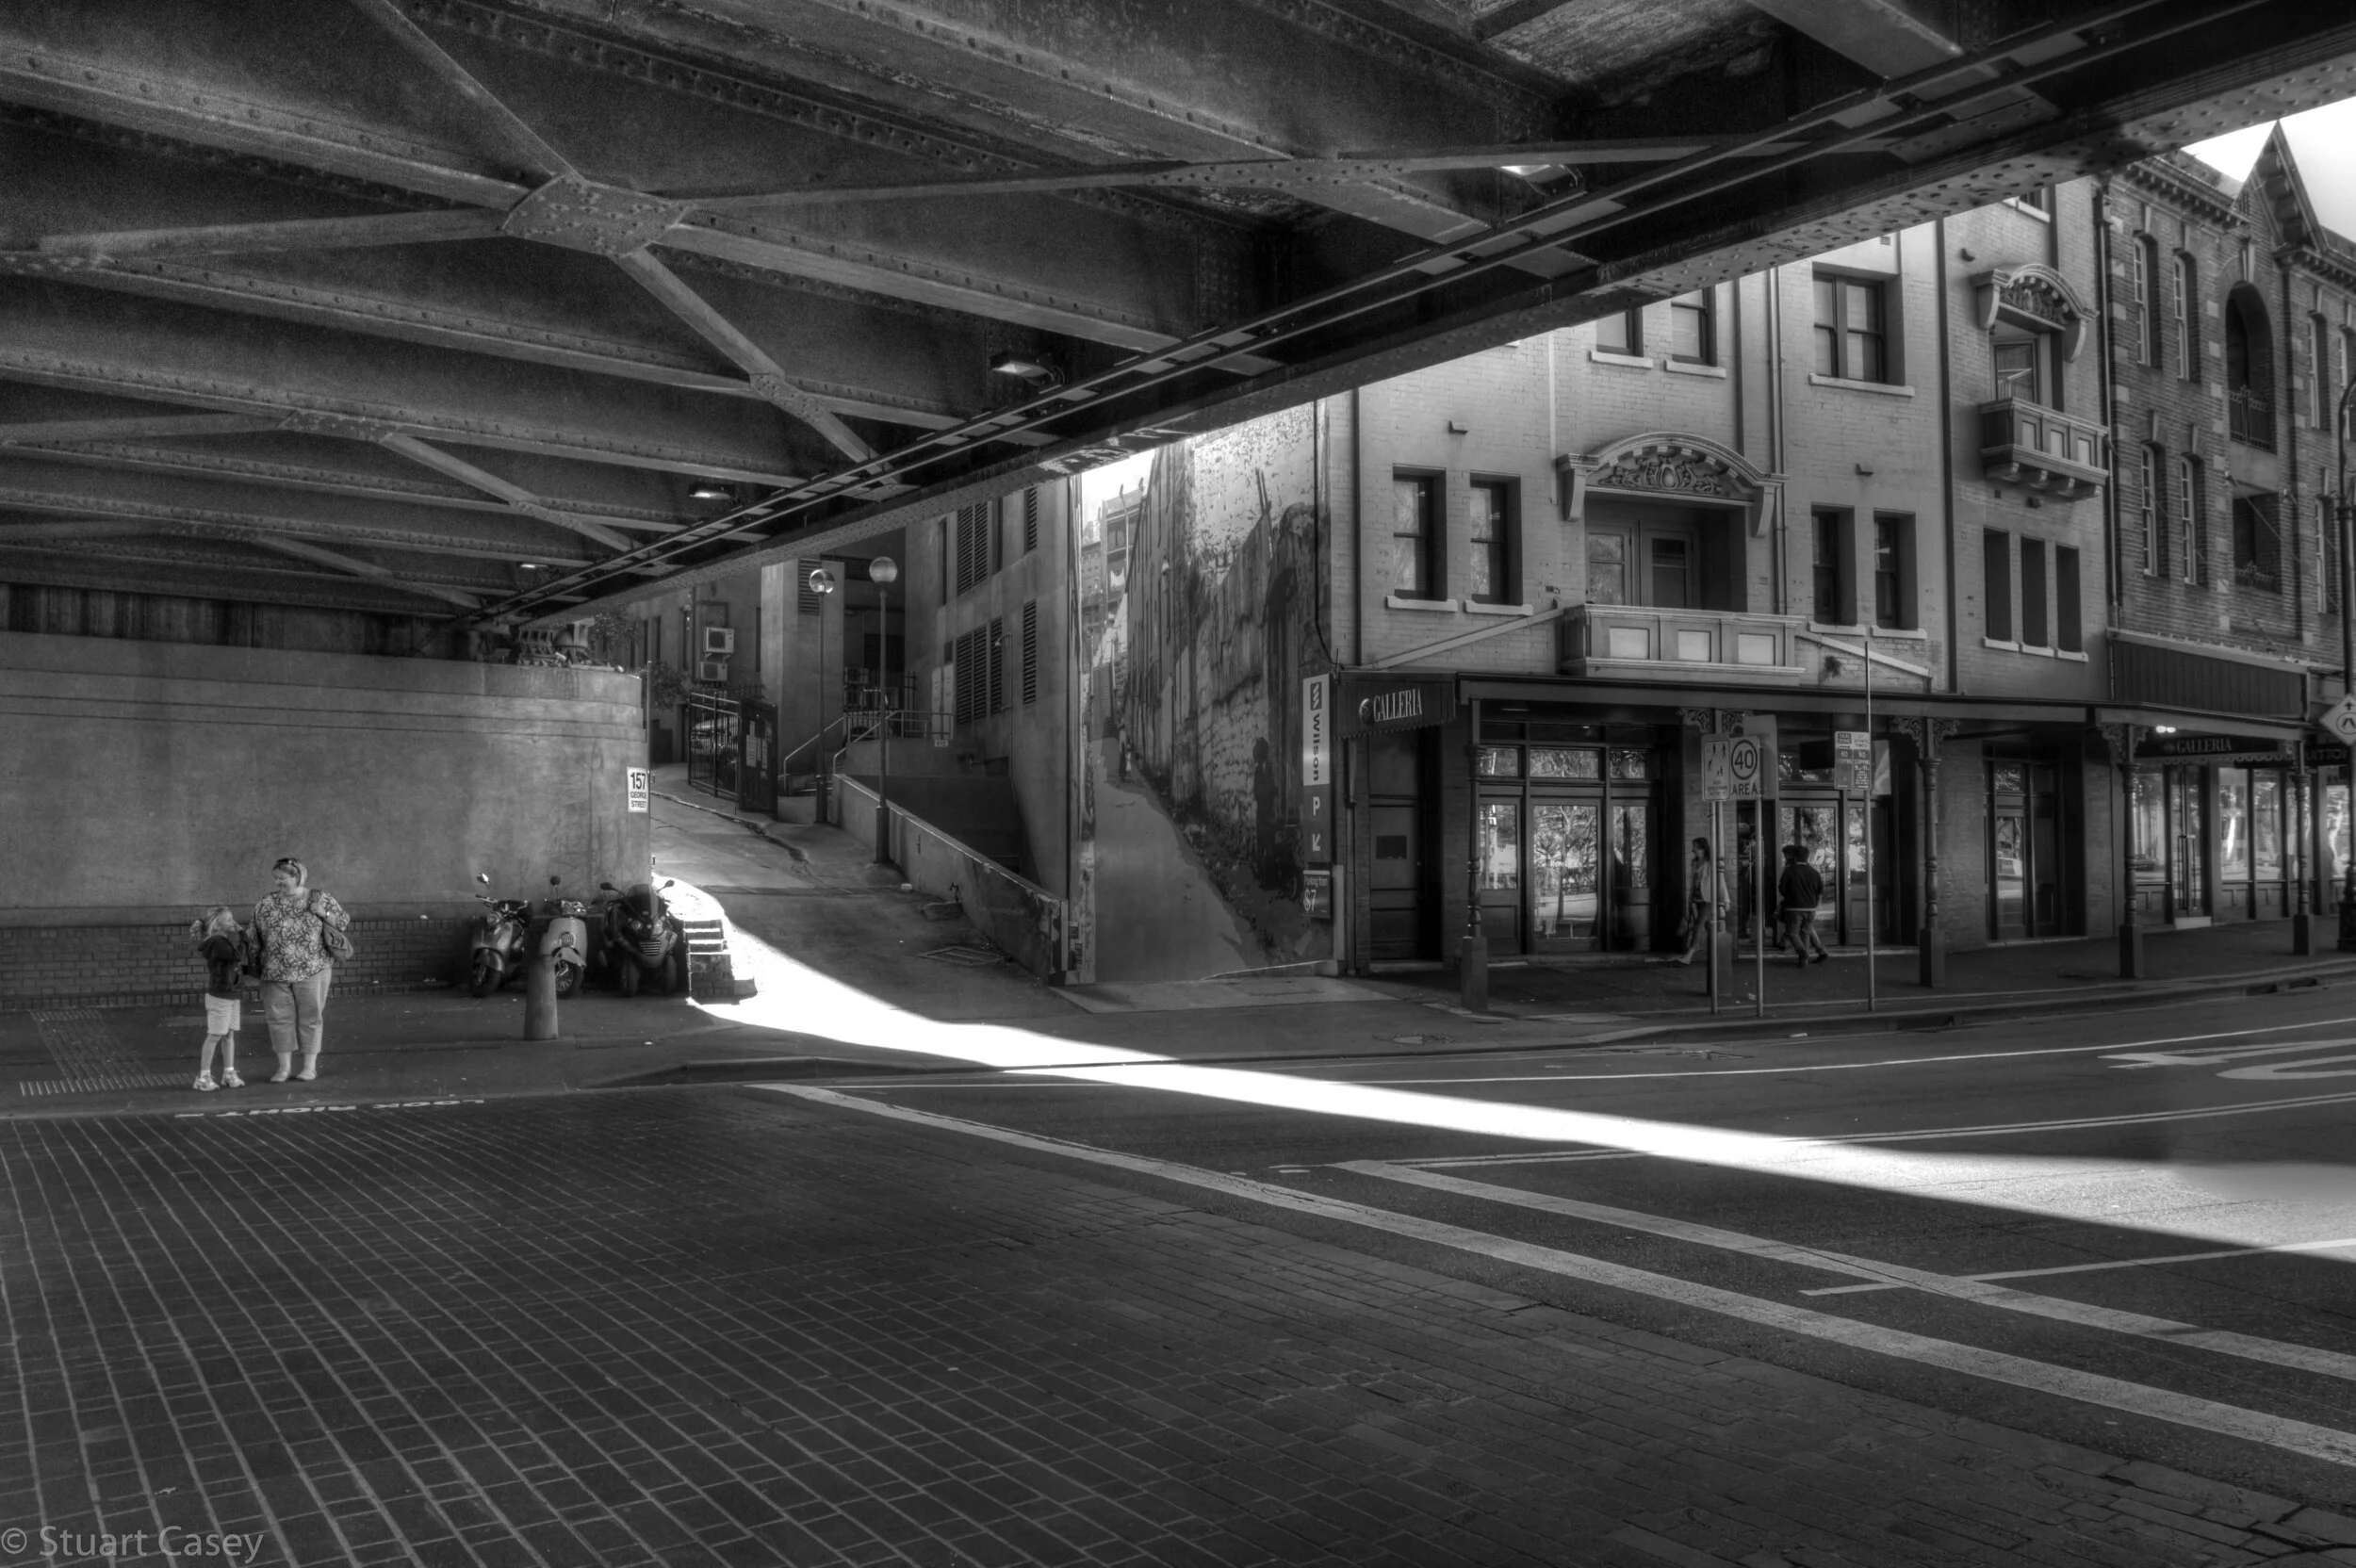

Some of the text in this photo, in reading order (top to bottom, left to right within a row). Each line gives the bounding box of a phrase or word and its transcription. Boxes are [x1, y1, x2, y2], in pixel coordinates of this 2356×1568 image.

[1373, 687, 1422, 722] GALLERIA
[2177, 738, 2232, 754] GALLERIA
[1734, 749, 1754, 769] 40
[630, 772, 646, 790] 157
[1732, 782, 1758, 795] AREA
[1313, 796, 1320, 815] P
[1304, 888, 1317, 914] $7
